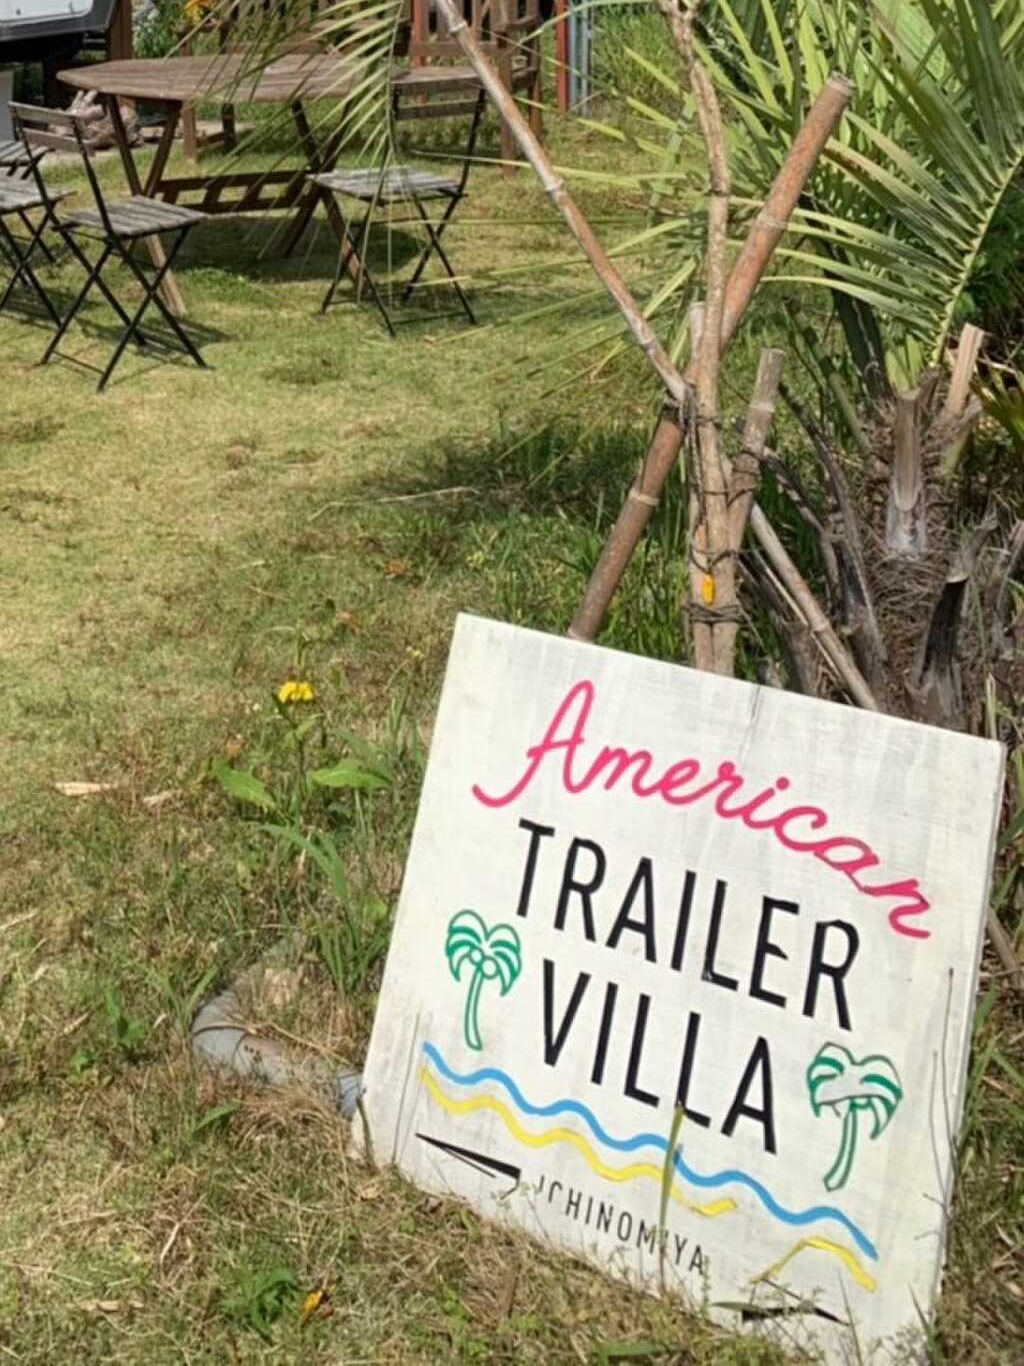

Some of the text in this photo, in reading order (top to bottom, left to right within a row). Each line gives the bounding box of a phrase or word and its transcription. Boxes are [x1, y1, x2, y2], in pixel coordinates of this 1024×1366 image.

[473, 680, 931, 939] American
[517, 818, 861, 1032] TRAILER
[542, 959, 777, 1156] VILLA
